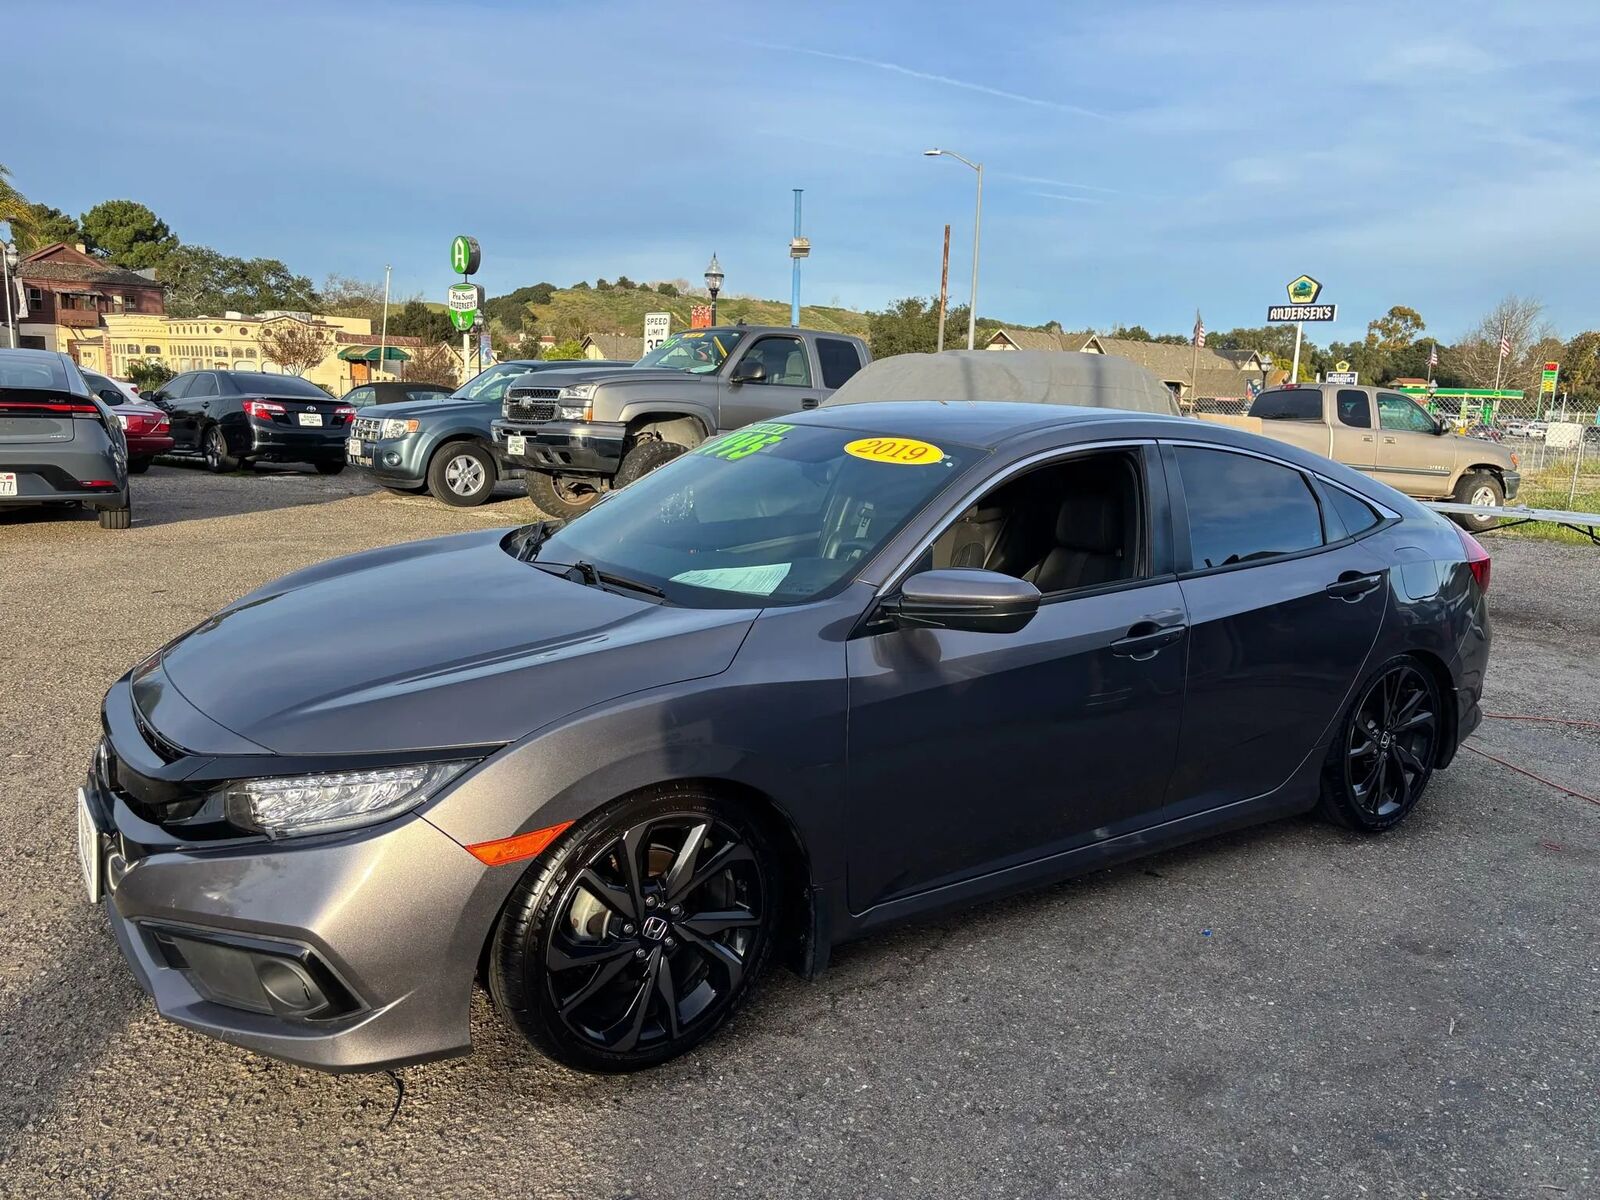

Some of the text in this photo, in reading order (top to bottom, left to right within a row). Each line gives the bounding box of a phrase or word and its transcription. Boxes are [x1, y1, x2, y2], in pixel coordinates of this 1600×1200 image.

[454, 237, 466, 269] A
[461, 292, 474, 301] Soup
[1270, 307, 1331, 319] ANDERSEN'S
[855, 439, 928, 461] 2019
